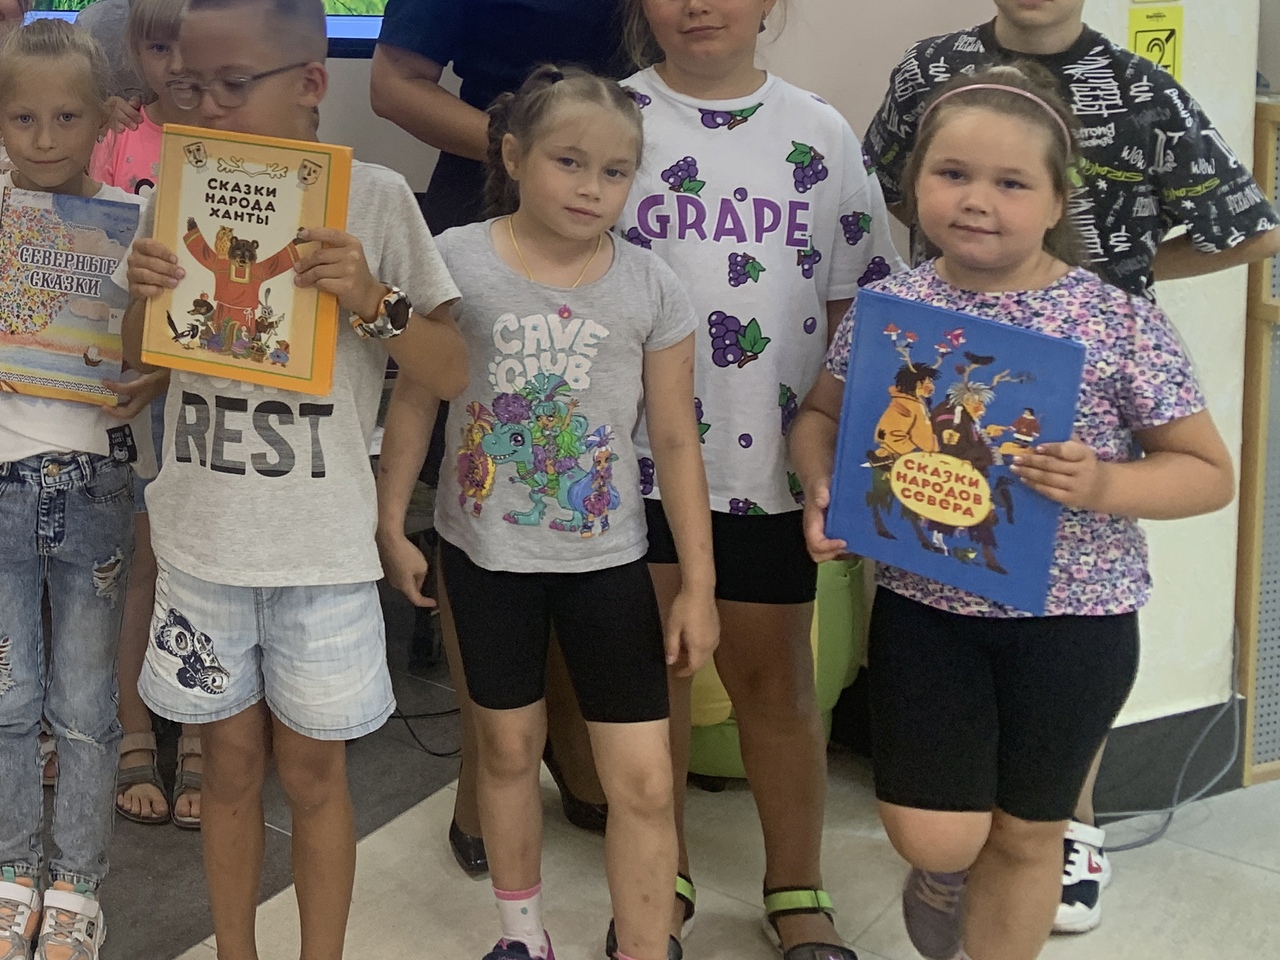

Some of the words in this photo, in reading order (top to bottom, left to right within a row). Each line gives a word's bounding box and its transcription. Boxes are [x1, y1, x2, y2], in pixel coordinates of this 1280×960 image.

[204, 192, 276, 212] НАРОДА
[207, 177, 278, 199] СКАЗКИ
[208, 206, 270, 226] ХАНТЫ
[636, 192, 811, 249] GRAPE
[20, 246, 118, 276] СЕВЕРНЫЕ
[30, 270, 100, 297] СКАЗКИ
[492, 312, 610, 358] CAVE
[494, 351, 593, 394] CLUB
[174, 390, 335, 479] REST
[896, 470, 983, 506] НАРОДОВ
[904, 458, 980, 490] СКАЗКИ
[901, 487, 974, 519] СЕВЕРА
